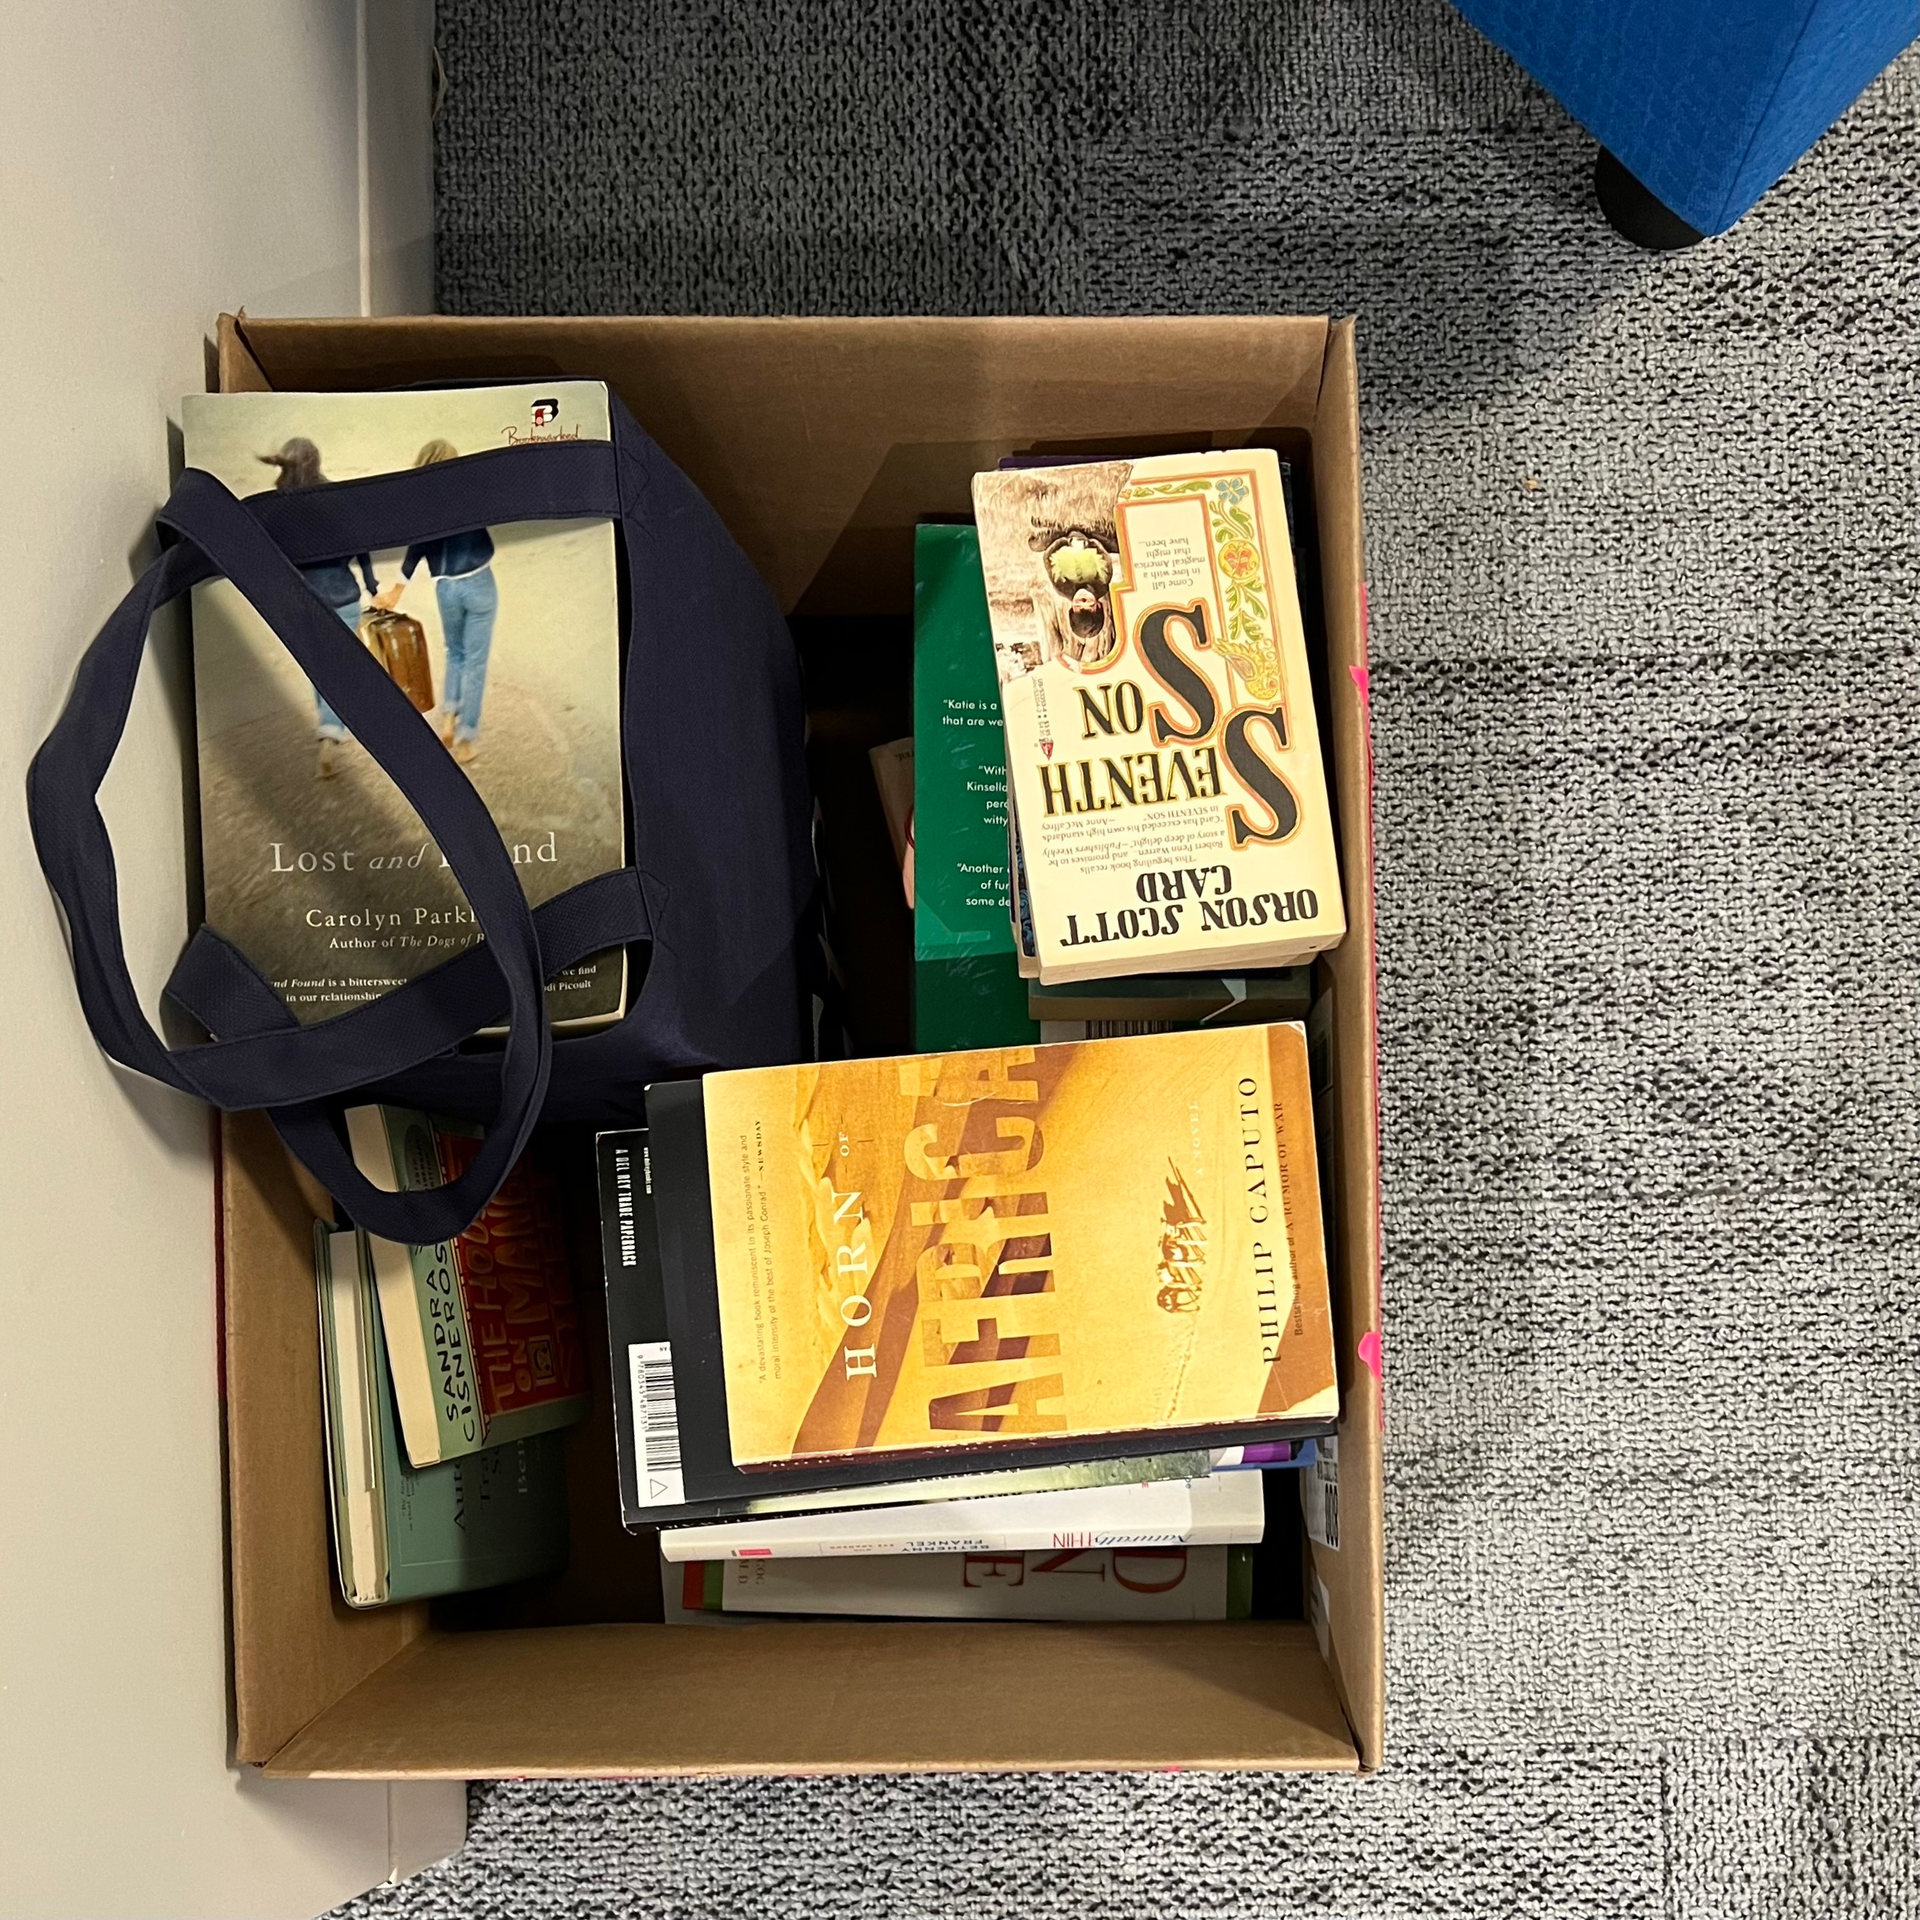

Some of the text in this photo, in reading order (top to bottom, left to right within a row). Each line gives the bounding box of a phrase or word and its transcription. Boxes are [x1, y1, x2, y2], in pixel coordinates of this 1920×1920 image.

[1169, 537, 1189, 546] have
[1146, 547, 1191, 558] that might
[1134, 556, 1205, 569] magical America
[1151, 570, 1170, 578] with
[1172, 568, 1189, 577] love
[1152, 578, 1193, 590] Come fall
[1073, 599, 1218, 747] SON
[943, 699, 975, 710] "Katie
[979, 699, 987, 710] is
[942, 716, 964, 726] that
[1036, 704, 1302, 852] SEVENTH
[1168, 807, 1208, 818] SEVENTH
[1042, 821, 1083, 831] McCaffrey
[1127, 824, 1139, 833] his
[1142, 820, 1181, 831] exceeded
[1183, 818, 1197, 826] has
[1086, 828, 1105, 838] high
[1107, 826, 1125, 834] own
[1197, 831, 1218, 839] story
[1042, 832, 1084, 843] standards
[1164, 835, 1185, 843] deep
[1187, 834, 1195, 843] of
[1171, 844, 1193, 852] Penn
[1194, 841, 1223, 850] Robert
[269, 843, 355, 872] Lost
[369, 843, 429, 869] and
[1042, 848, 1073, 858] Weekly
[1071, 850, 1110, 863] promises
[1112, 851, 1128, 861] and
[957, 863, 1004, 873] "Another
[1048, 859, 1058, 867] be
[1110, 862, 1131, 872] book
[1133, 857, 1173, 867] beguiling
[1080, 865, 1108, 875] recalls
[981, 881, 991, 890] of
[1136, 865, 1232, 903] CARD
[966, 898, 994, 907] some
[305, 908, 402, 930] Carolyn
[1060, 889, 1319, 947] ORSON SCOTT
[329, 937, 377, 949] Author
[381, 936, 394, 947] of
[400, 936, 422, 947] The
[427, 935, 455, 948] Dogs
[461, 933, 473, 948] of
[271, 979, 287, 988] nd
[291, 978, 325, 988] Found
[328, 978, 337, 987] is
[578, 965, 597, 975] find
[286, 994, 297, 1002] in
[559, 980, 592, 991] Picoult
[1273, 1102, 1284, 1134] WAR
[1188, 1100, 1202, 1159] NOVEL
[739, 1135, 748, 1151] and
[1277, 1142, 1287, 1158] OF
[616, 1157, 630, 1172] DEL
[741, 1154, 751, 1173] style
[617, 1174, 631, 1189] REY
[1279, 1163, 1292, 1215] RUMOR
[618, 1192, 633, 1217] TRADE
[743, 1176, 755, 1221] passionate
[1237, 1077, 1281, 1365] PHILIP CAPUTO
[1285, 1222, 1293, 1231] A
[747, 1224, 755, 1233] its
[620, 1220, 637, 1267] PAPERBACK
[747, 1237, 755, 1245] in
[761, 1224, 771, 1253] Joseph
[898, 1047, 1067, 1432] AFRICA
[1286, 1237, 1295, 1246] of
[764, 1257, 772, 1265] of
[830, 1131, 877, 1381] HORN OF
[1288, 1249, 1298, 1280] author
[748, 1247, 760, 1297] reminiscent
[765, 1268, 774, 1286] best
[767, 1289, 775, 1302] the
[461, 1209, 515, 1413] THE HOU
[753, 1300, 762, 1320] book
[768, 1305, 776, 1314] of
[769, 1316, 779, 1352] intensity
[425, 1269, 459, 1422] SANDRA
[434, 1243, 475, 1442] CISNEROS
[756, 1323, 766, 1371] devastating
[508, 1339, 531, 1392] ON
[772, 1355, 781, 1380] moral
[640, 1399, 648, 1430] 487131
[1053, 1531, 1193, 1548] Naturally THIN
